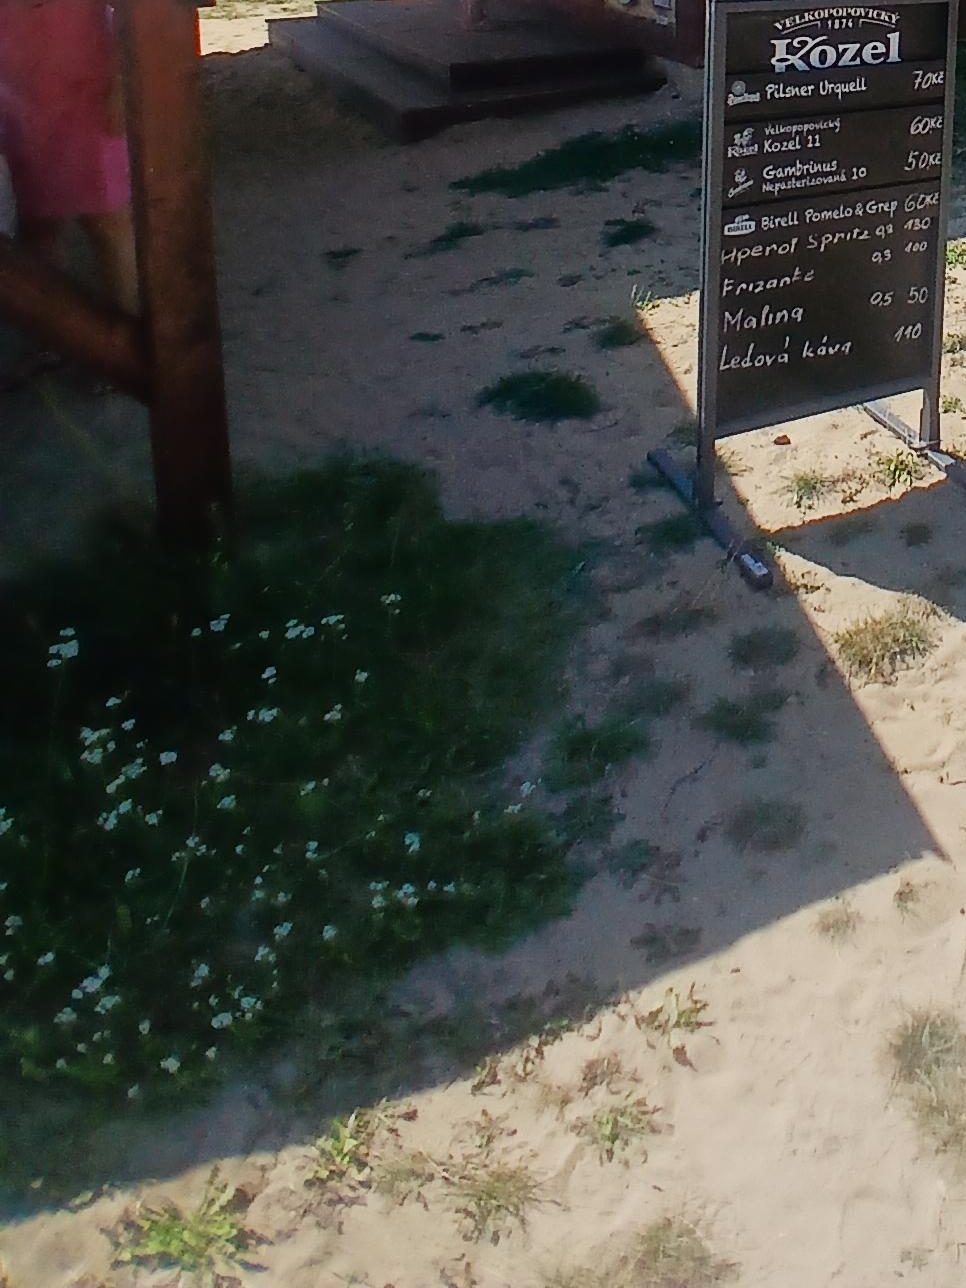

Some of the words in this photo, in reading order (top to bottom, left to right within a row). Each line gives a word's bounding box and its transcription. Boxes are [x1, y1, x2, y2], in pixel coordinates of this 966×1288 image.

[773, 7, 900, 31] VELKOPOPOVICKÝ
[770, 31, 902, 73] Kozel
[765, 83, 815, 100] Pilsner
[819, 76, 868, 101] Urquell
[764, 117, 841, 137] Velkopopovický
[763, 134, 801, 154] Kozel
[807, 134, 821, 148] 11
[762, 159, 838, 180] Gambrinus
[762, 170, 847, 196] Nepasterizovaná
[851, 167, 867, 180] 10
[761, 211, 799, 231] Birell
[805, 204, 853, 223] Pomelo
[866, 200, 898, 218] Grep
[806, 227, 871, 252] Spritz
[722, 266, 815, 297] Frizante
[870, 291, 894, 307] 0,5
[906, 286, 929, 304] 50
[723, 304, 804, 333] Malina
[719, 336, 789, 371] Ledová
[802, 335, 852, 359] káva
